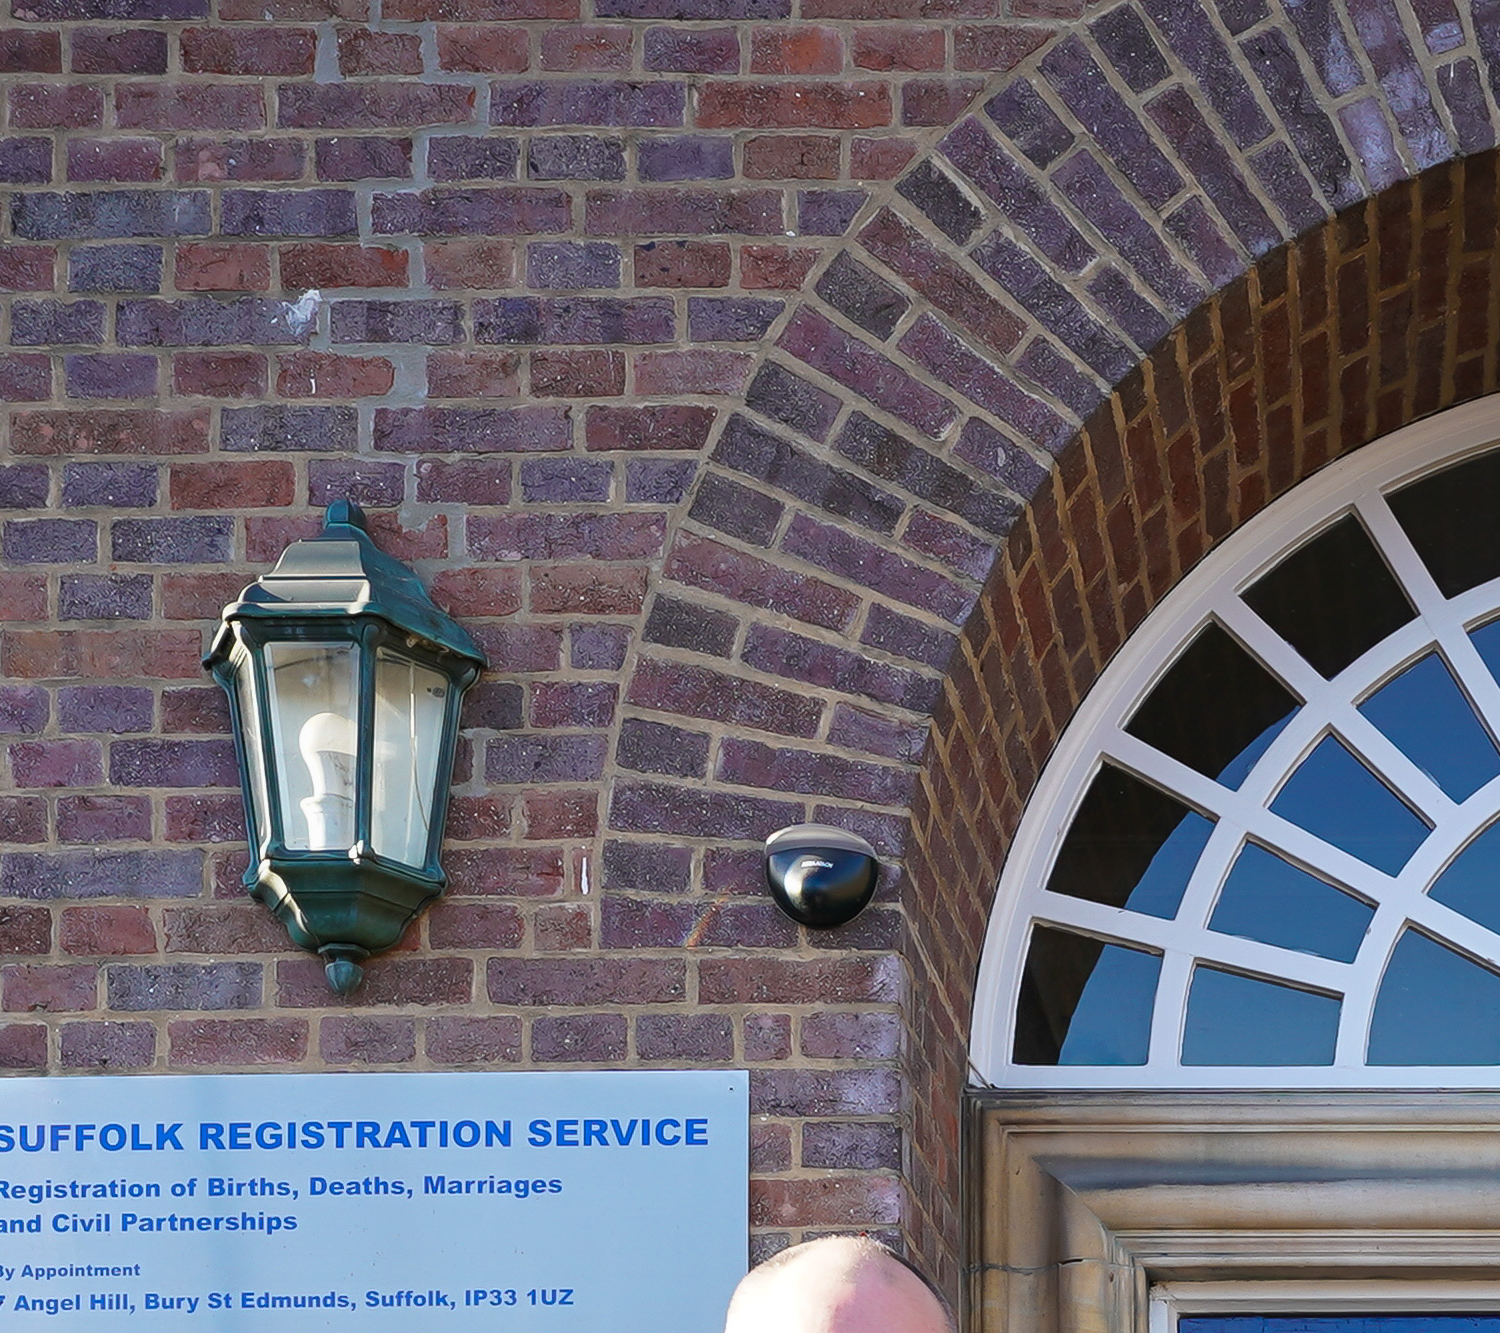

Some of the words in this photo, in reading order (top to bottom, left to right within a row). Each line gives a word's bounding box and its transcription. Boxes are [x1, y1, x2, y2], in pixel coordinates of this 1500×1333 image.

[199, 1120, 511, 1151] REGISTRATION
[528, 1118, 708, 1148] SERVICE
[171, 1177, 197, 1197] of
[208, 1176, 299, 1200] Births,
[309, 1176, 414, 1200] Deaths,
[423, 1174, 563, 1199] Marriages
[52, 1212, 111, 1233] Civil
[121, 1211, 298, 1236] Partnerships
[21, 1262, 141, 1281] Appointment
[14, 1294, 81, 1315] Angel
[90, 1293, 136, 1315] Hill,
[145, 1292, 200, 1314] Bury
[208, 1291, 233, 1309] St
[241, 1291, 357, 1312] Edmunds,
[365, 1290, 456, 1310] Suffolk,
[465, 1288, 518, 1306] IP33
[527, 1288, 575, 1306] 1UZ
